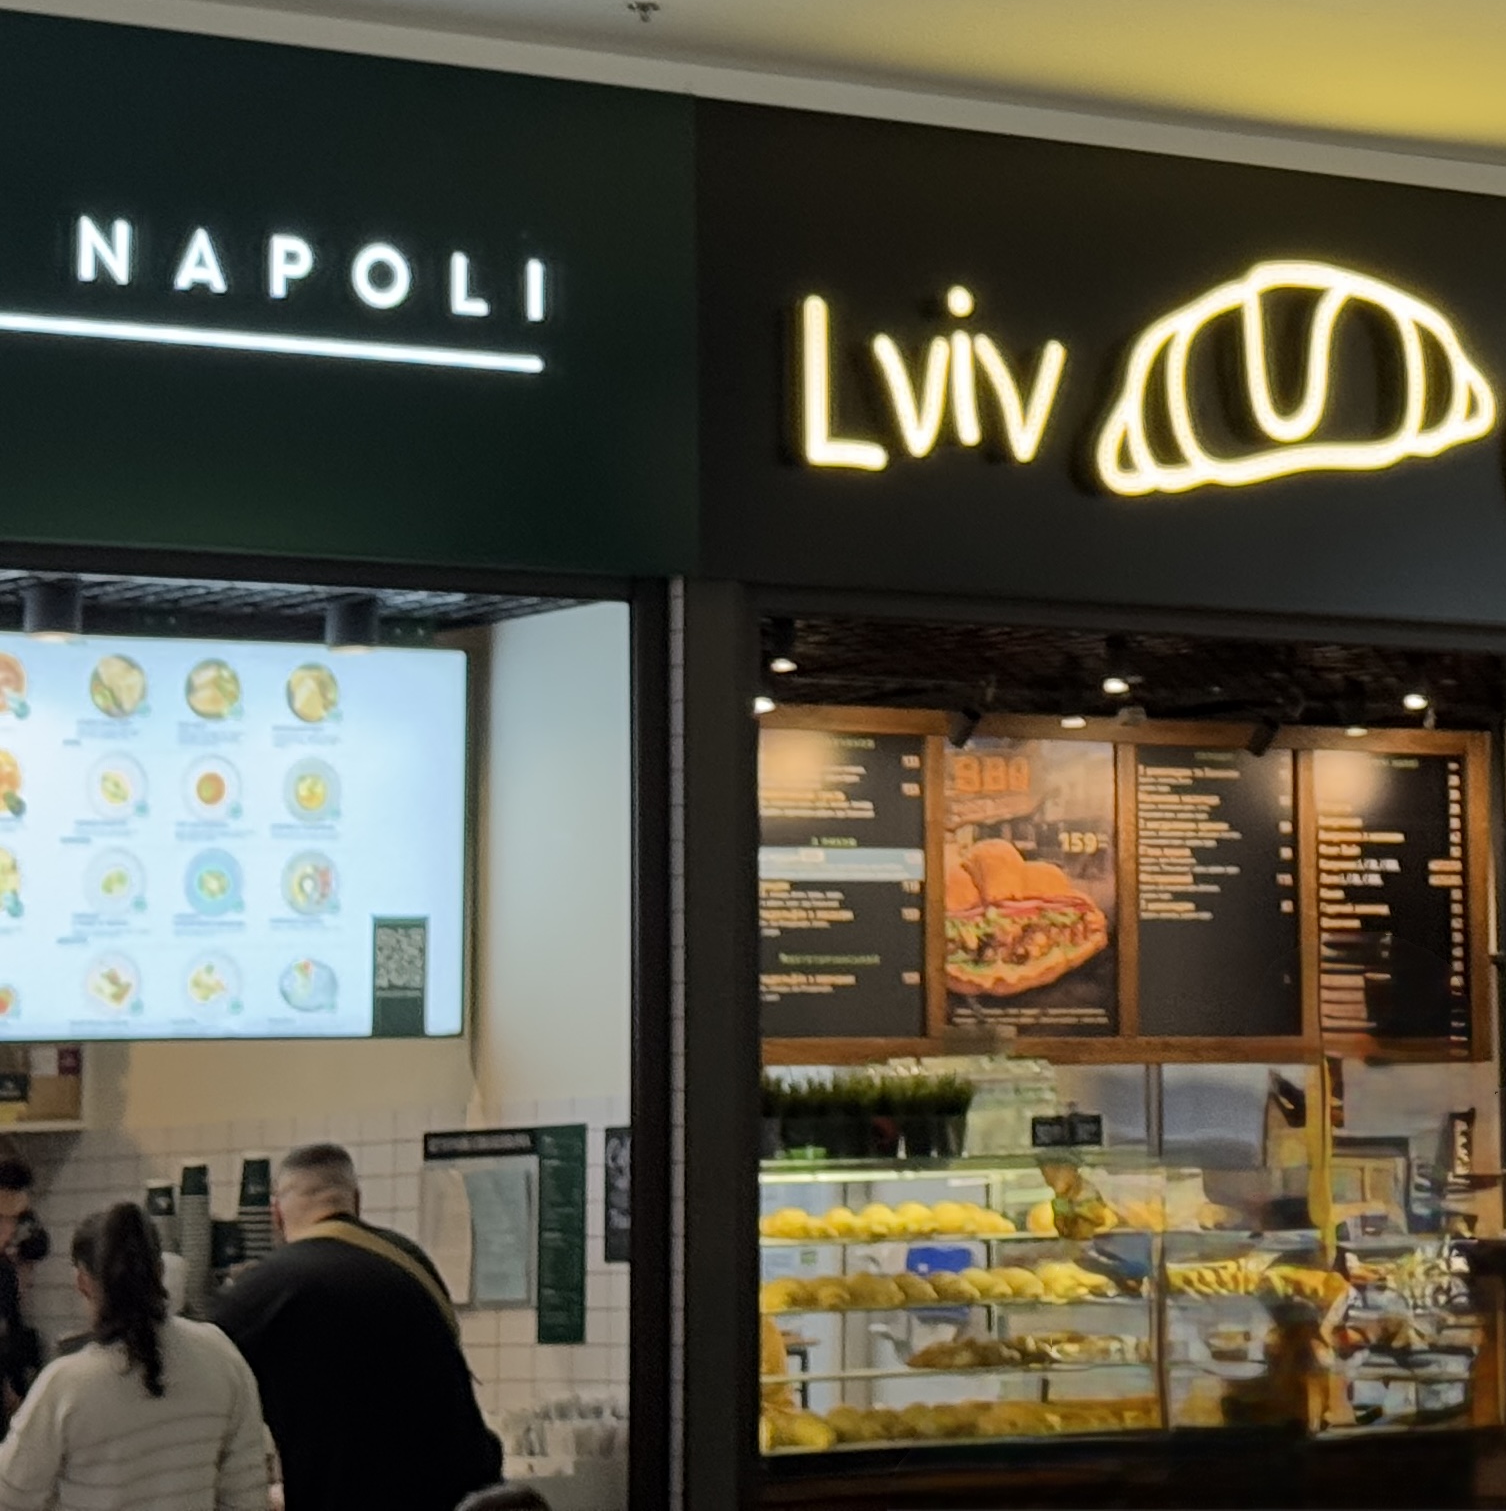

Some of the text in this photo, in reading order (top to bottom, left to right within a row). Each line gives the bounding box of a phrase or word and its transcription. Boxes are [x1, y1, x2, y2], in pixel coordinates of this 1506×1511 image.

[77, 215, 546, 322] NAPOLI
[803, 285, 1067, 471] Lviv
[1058, 831, 1098, 855] 159
